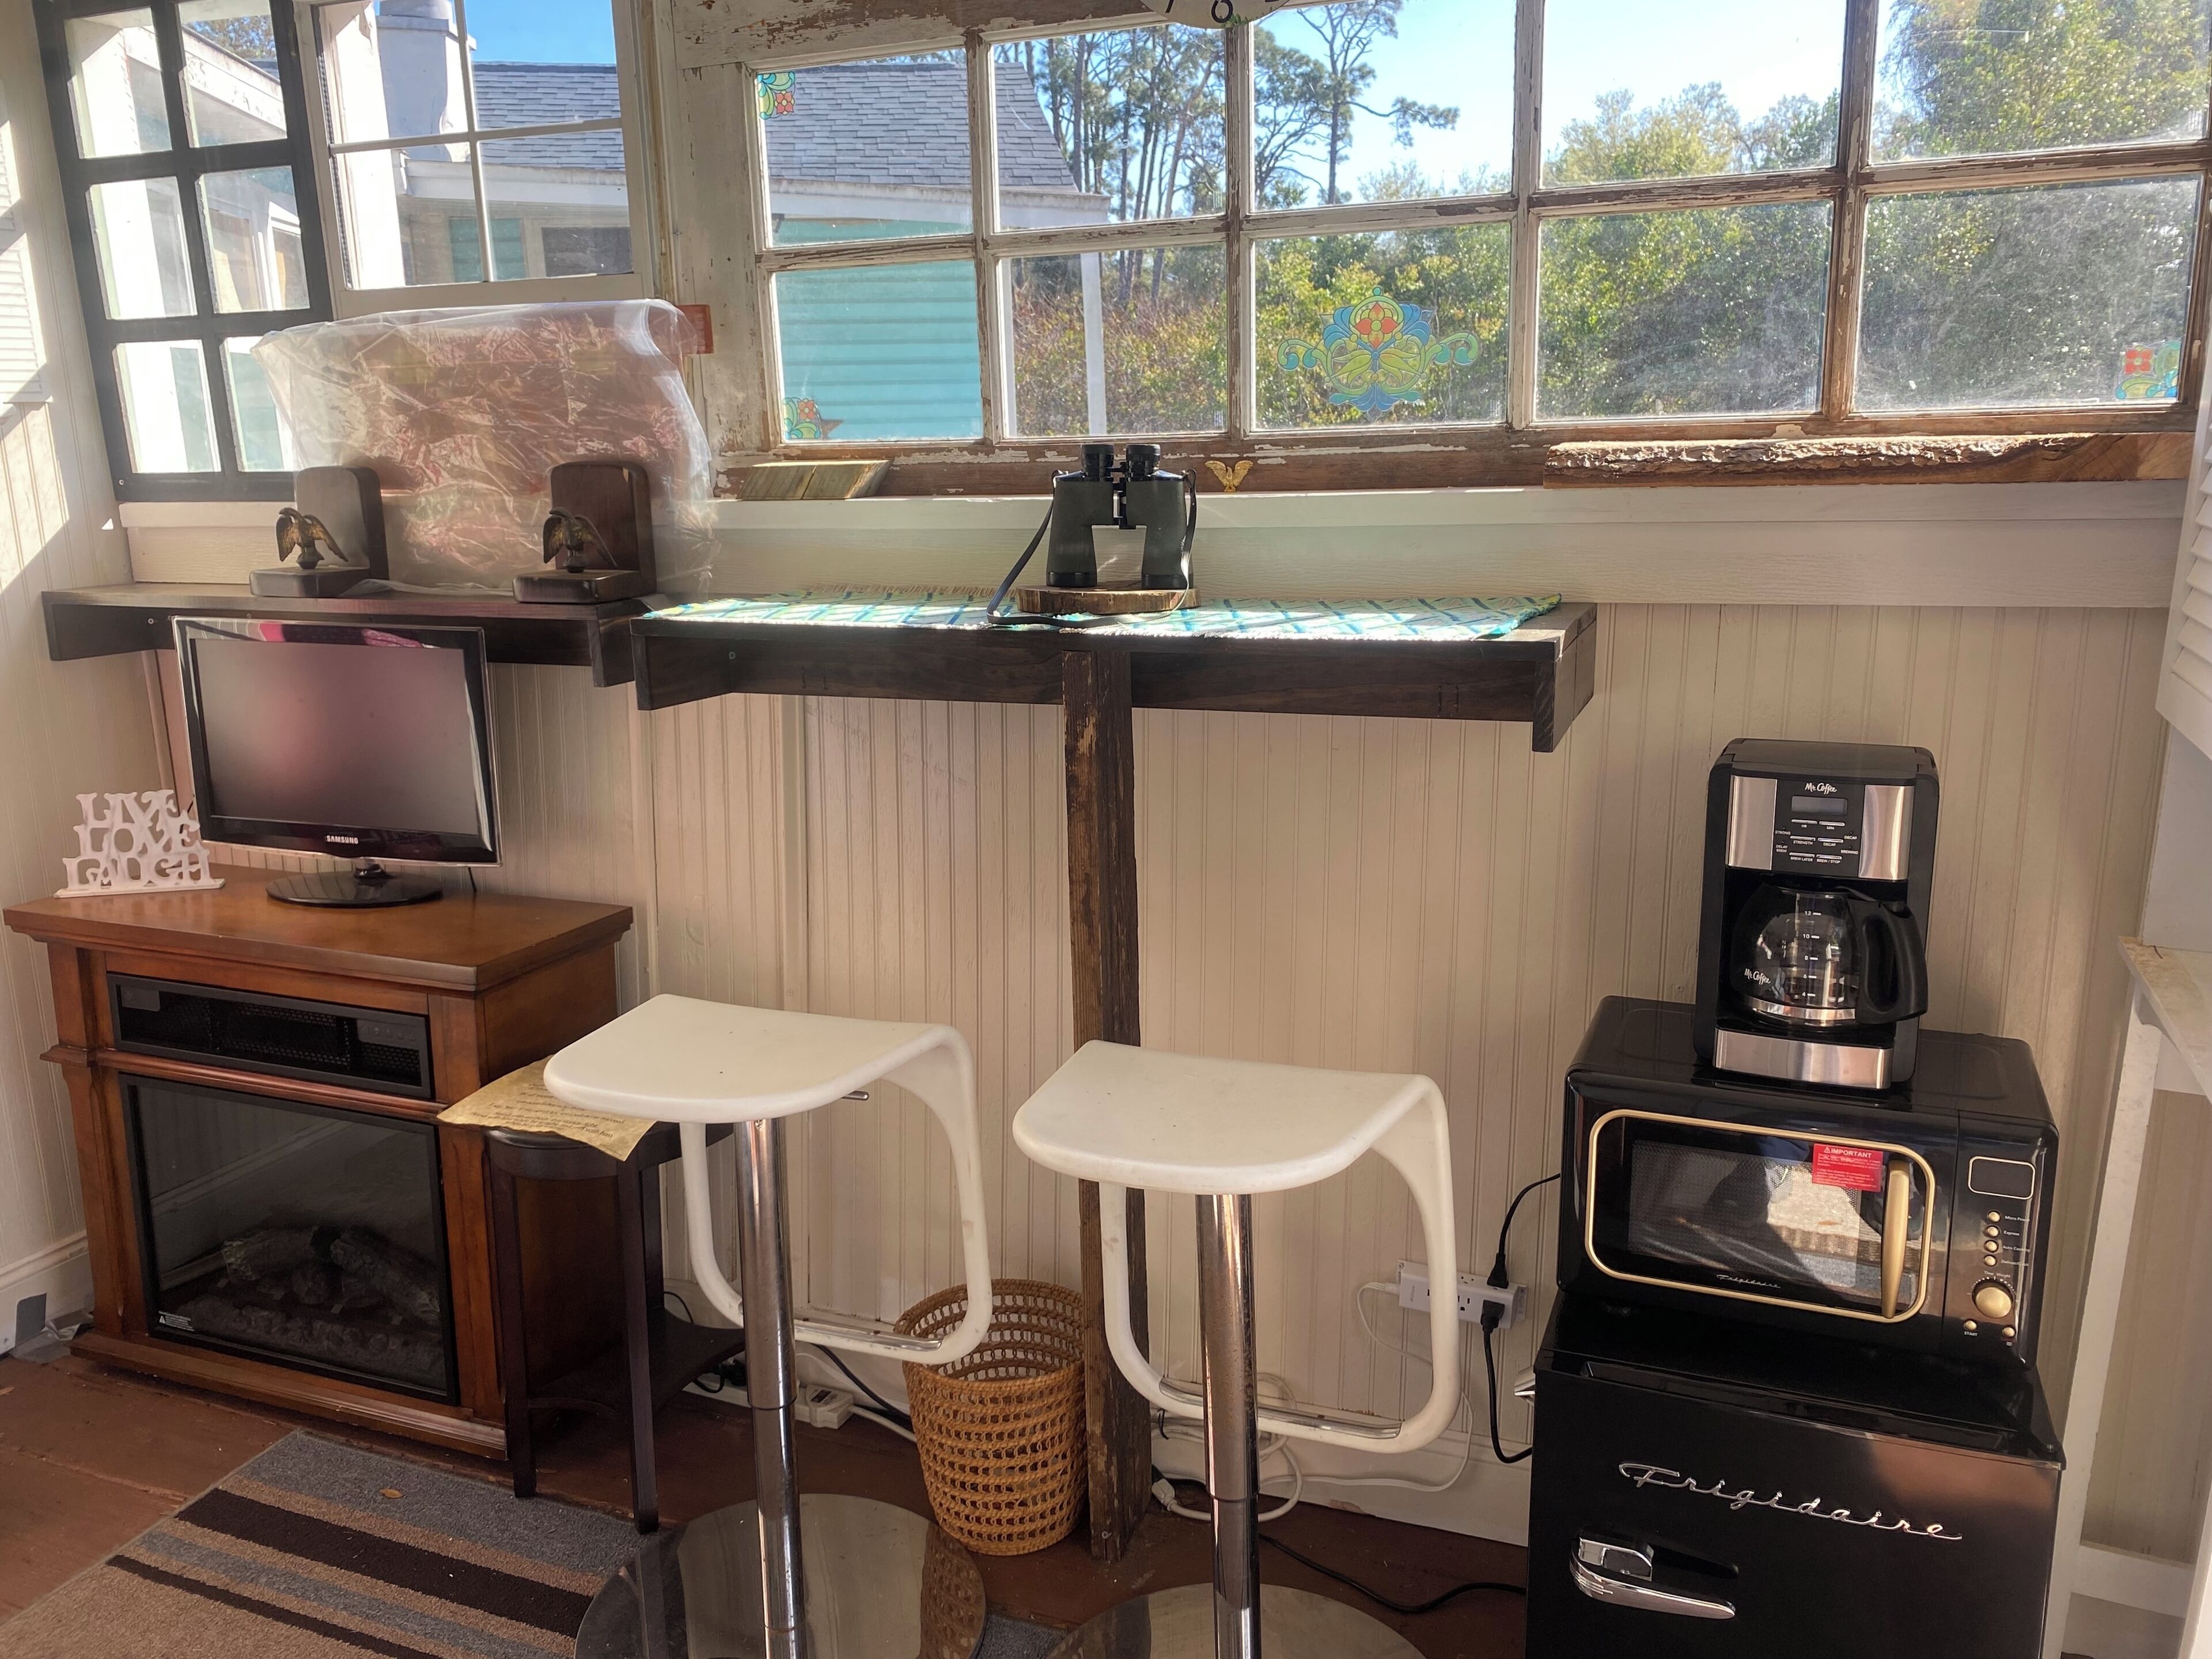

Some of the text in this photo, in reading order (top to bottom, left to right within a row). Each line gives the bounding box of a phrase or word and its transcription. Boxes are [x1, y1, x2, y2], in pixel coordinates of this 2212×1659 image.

[1804, 782, 1838, 795] Mr. Coffee
[73, 819, 202, 857] LOVE
[326, 835, 359, 844] SAMSUNG
[1753, 971, 1771, 986] Coffee
[1831, 1147, 1872, 1158] IMPORTANT
[1716, 1274, 1782, 1289] Frigidaire
[1619, 1461, 1963, 1541] Frigidaire
